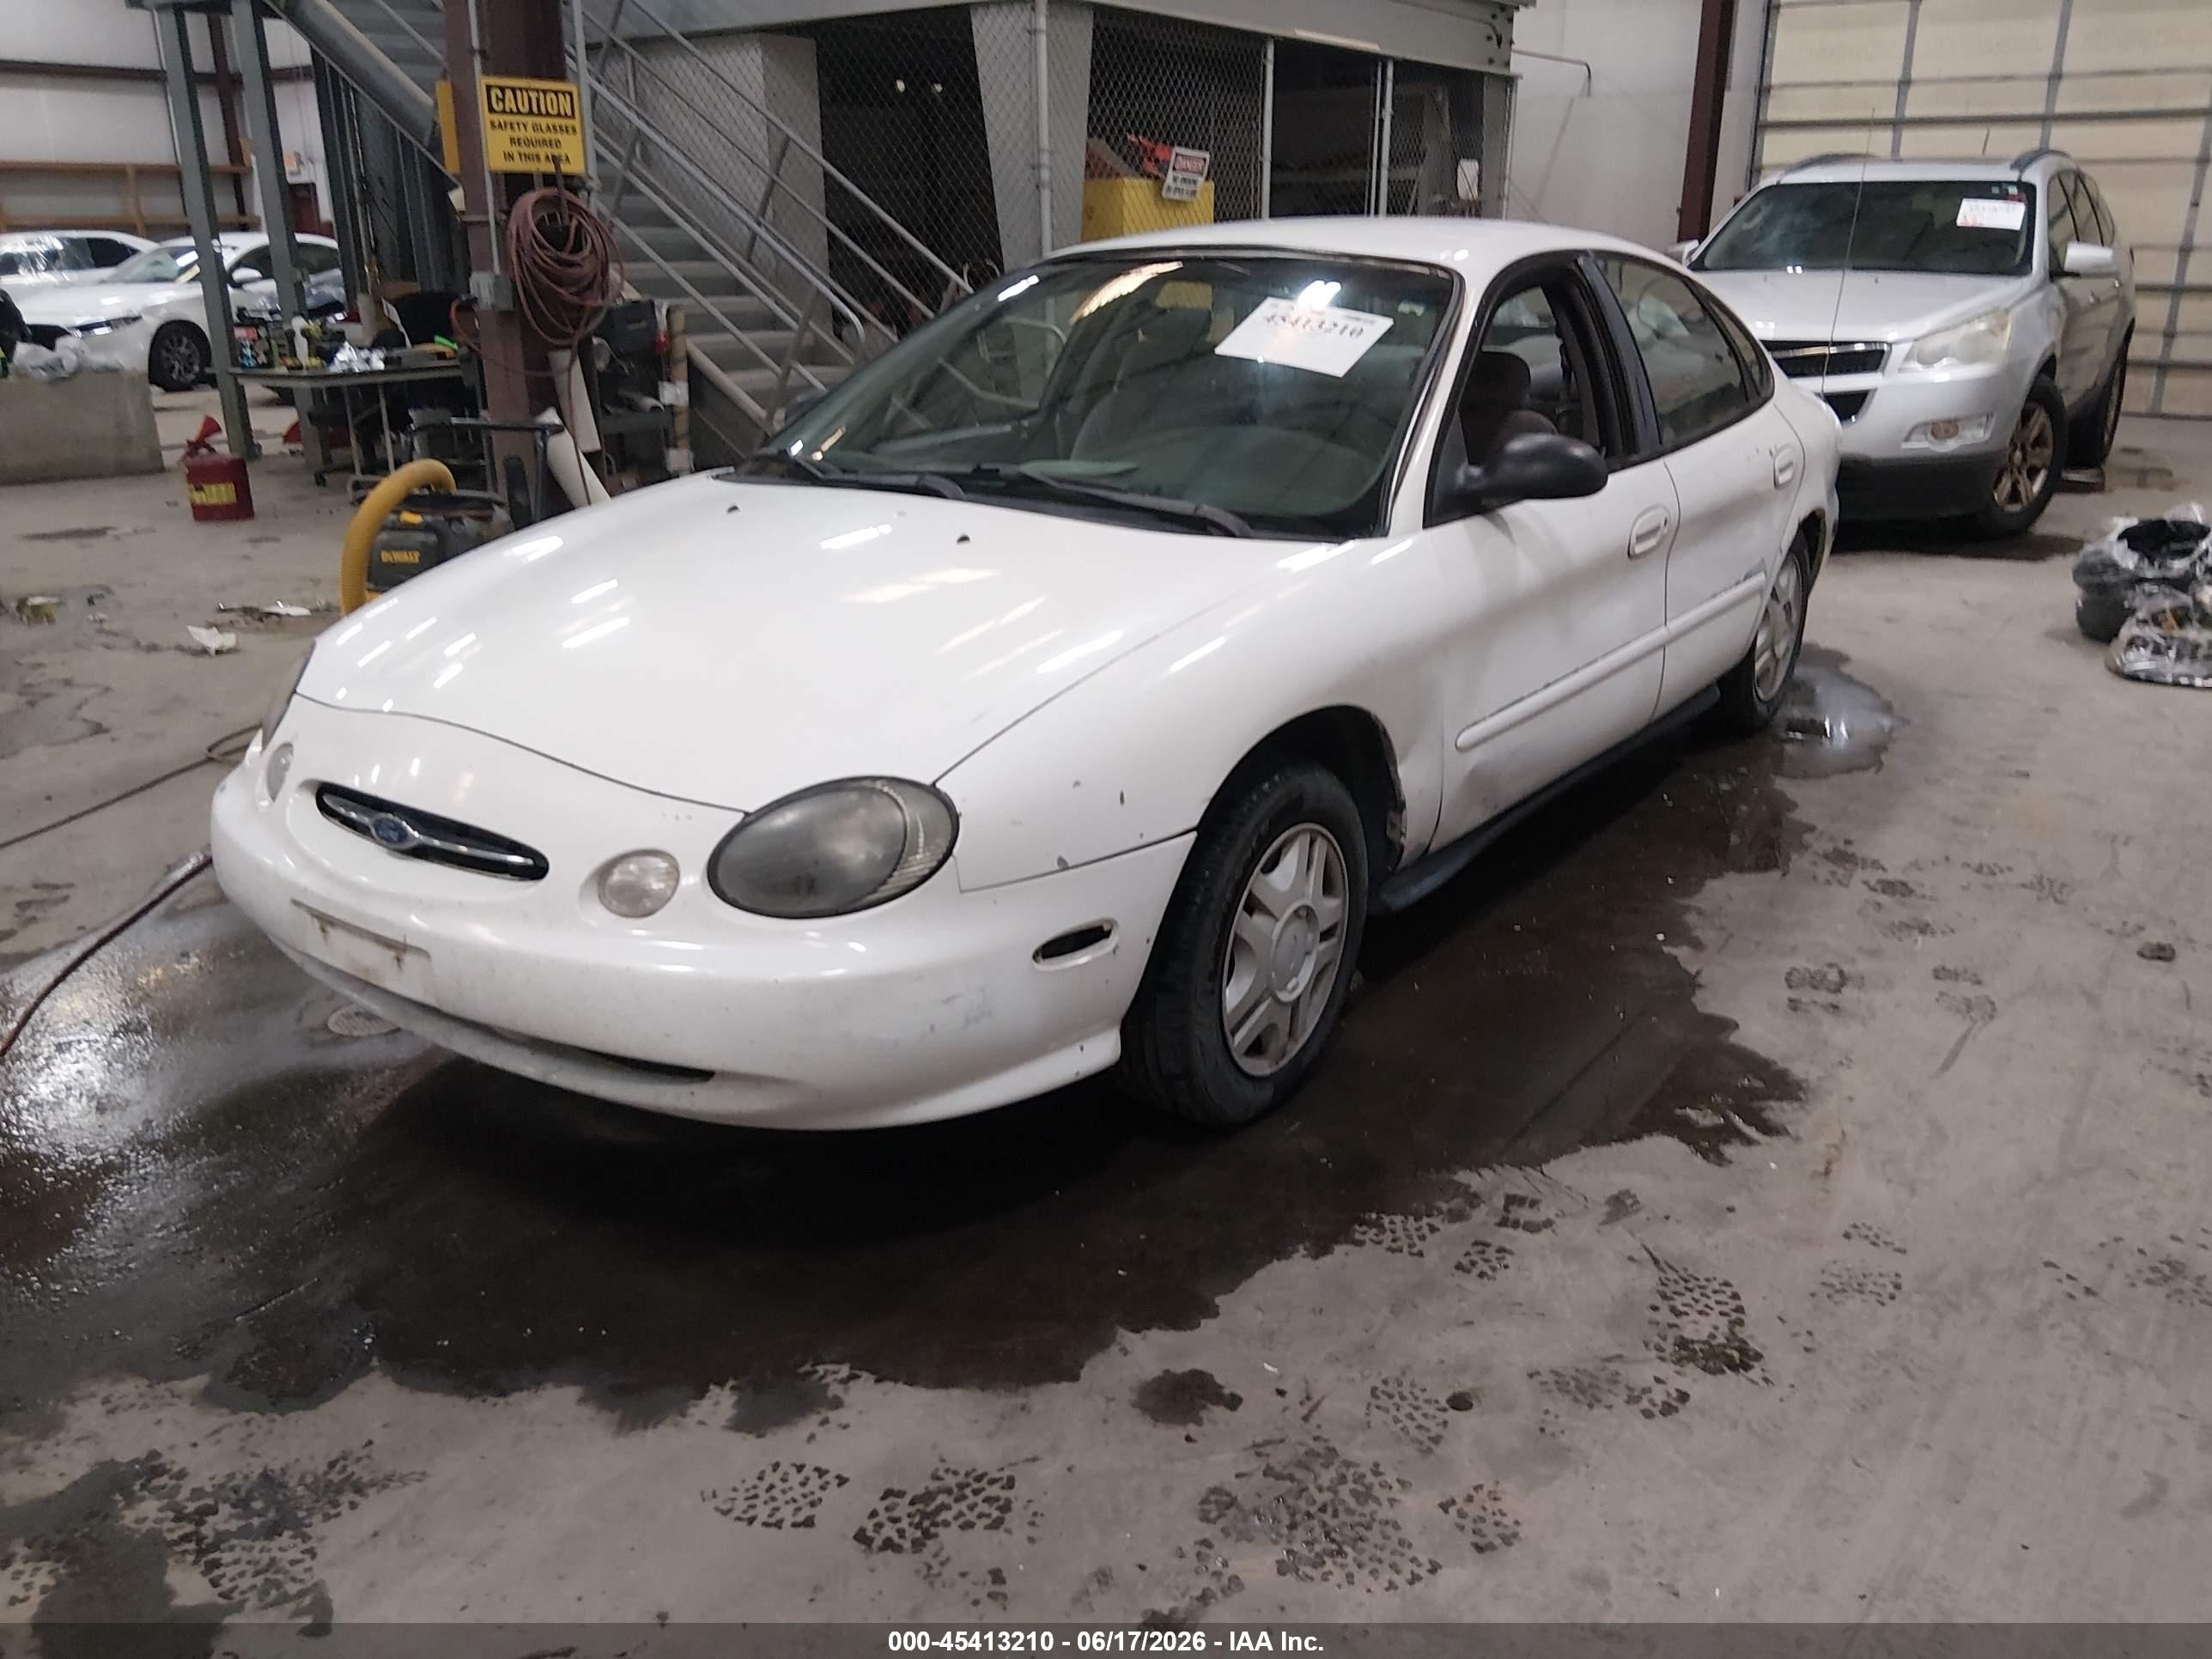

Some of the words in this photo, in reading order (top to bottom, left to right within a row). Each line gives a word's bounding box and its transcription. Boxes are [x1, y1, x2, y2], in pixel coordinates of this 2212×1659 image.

[489, 87, 573, 117] CAUTION
[489, 120, 528, 132] SAFETY
[532, 123, 577, 136] GLASSES
[509, 137, 562, 149] REQUIRED
[502, 151, 514, 162] IN
[518, 153, 541, 164] THIS
